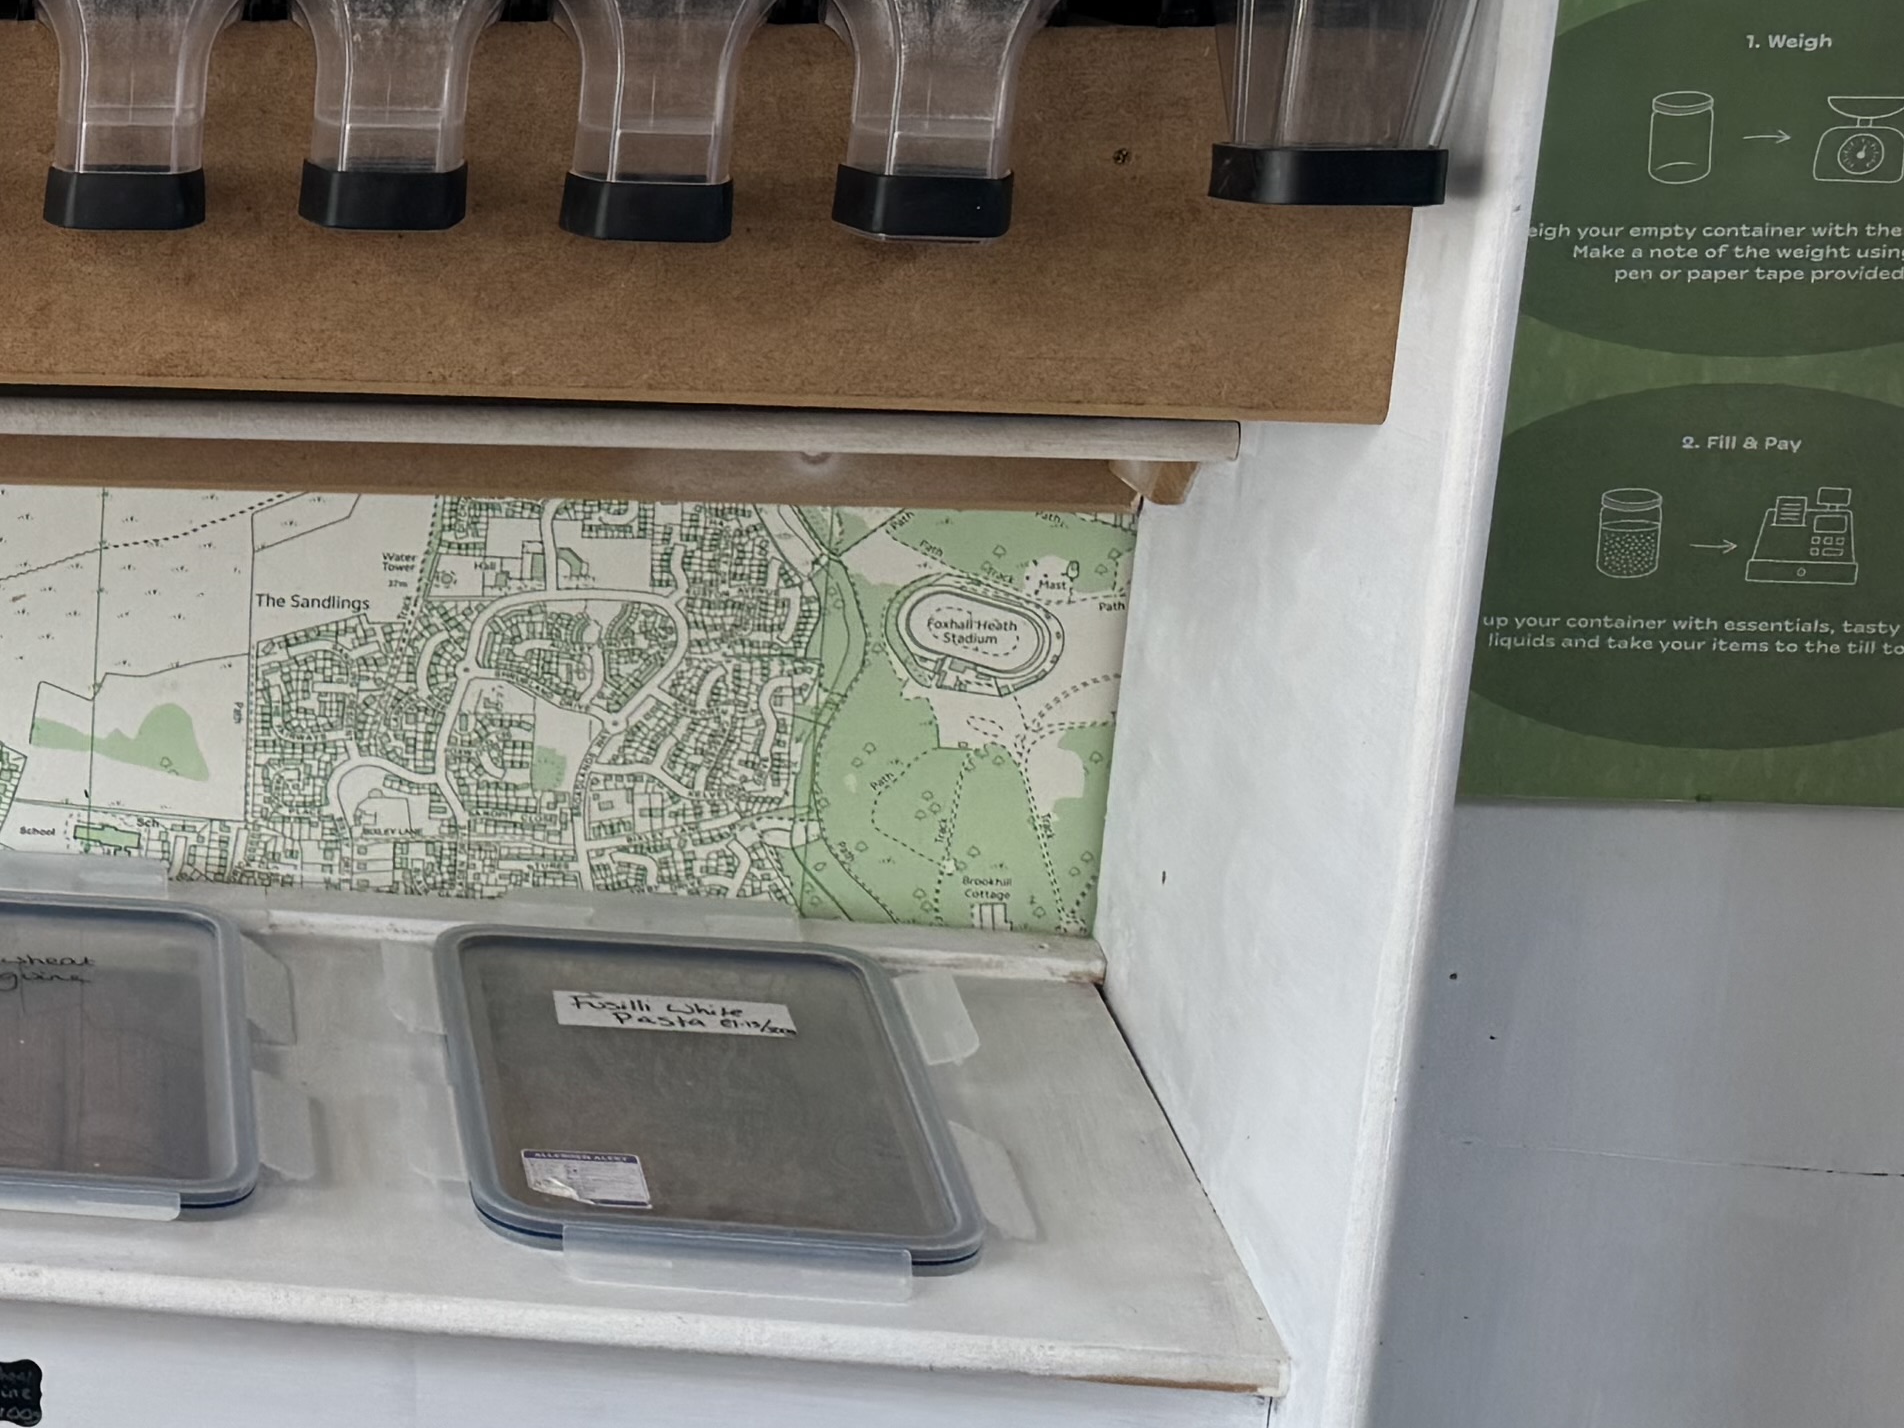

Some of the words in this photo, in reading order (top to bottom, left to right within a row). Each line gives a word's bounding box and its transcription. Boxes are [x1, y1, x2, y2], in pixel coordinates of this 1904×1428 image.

[1745, 34, 1761, 49] 1.
[1767, 34, 1833, 51] Weigh
[1577, 224, 1625, 240] your
[1629, 224, 1697, 240] empty
[1702, 223, 1805, 238] container
[1811, 222, 1859, 238] with
[1864, 222, 1903, 237] the
[1572, 244, 1626, 259] Make
[1631, 247, 1643, 259] a
[1648, 245, 1700, 259] note
[1704, 244, 1728, 259] of
[1733, 244, 1770, 259] the
[1776, 243, 1851, 262] weight
[1614, 267, 1653, 283] pen
[1659, 267, 1682, 280] or
[1686, 266, 1749, 283] paper
[1754, 266, 1805, 283] tape
[1681, 435, 1701, 449] 2.
[1707, 435, 1737, 450] Fill
[1742, 436, 1759, 450] &
[1764, 436, 1803, 454] Pay
[890, 510, 915, 531] Path
[919, 539, 944, 557] Path
[382, 552, 417, 563] Water
[382, 562, 416, 573] Tower
[1038, 579, 1067, 591] Mast
[256, 594, 286, 608] The
[290, 594, 370, 614] Sandlings
[1098, 601, 1126, 613] Path
[927, 618, 973, 631] Foxhall
[977, 620, 1018, 632] Heath
[1483, 615, 1509, 629] up
[1513, 616, 1561, 630] your
[1565, 614, 1667, 630] container
[1672, 616, 1718, 632] with
[1724, 617, 1836, 635] essentials,
[1841, 619, 1901, 638] tasty
[943, 632, 998, 645] Stadium
[1488, 634, 1556, 650] liquids
[1560, 634, 1600, 649] and
[1607, 635, 1653, 650] take
[1658, 637, 1706, 654] your
[1711, 637, 1769, 653] items
[1774, 639, 1798, 654] to
[1804, 639, 1841, 654] the
[1847, 639, 1876, 655] till
[962, 876, 1013, 887] Brookhill
[964, 889, 1011, 901] Cottage
[571, 994, 652, 1013] Fusilli
[667, 1003, 744, 1018] White
[612, 1011, 705, 1028] Pasta
